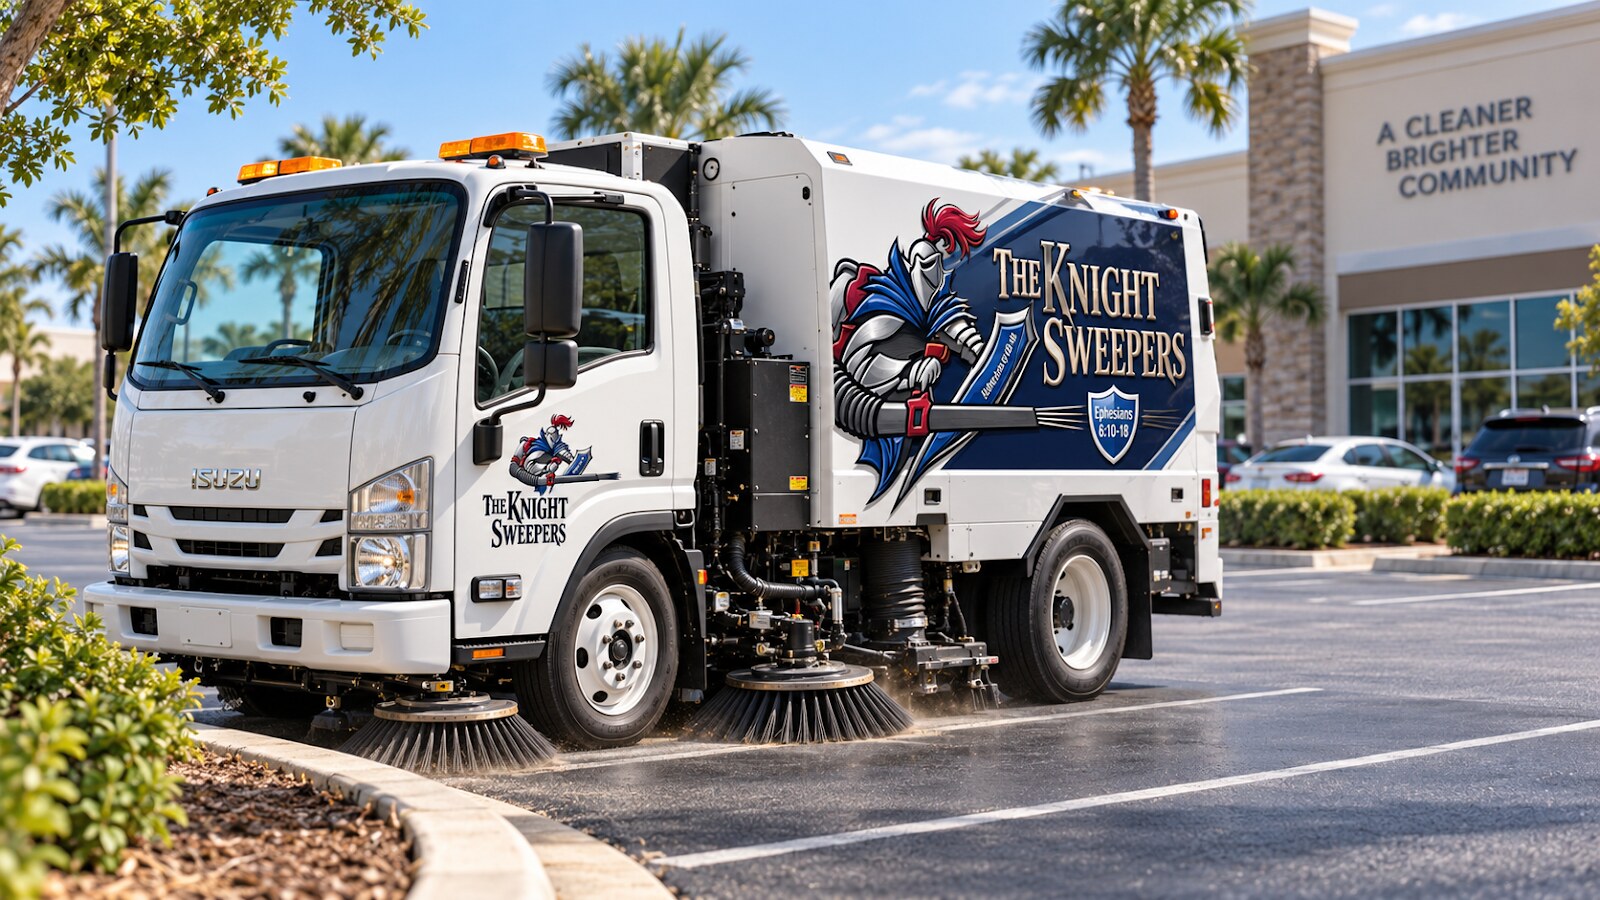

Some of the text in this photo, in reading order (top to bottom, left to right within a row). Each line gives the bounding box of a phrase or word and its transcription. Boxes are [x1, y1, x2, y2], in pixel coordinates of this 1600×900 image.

[1377, 96, 1532, 145] A CLEANER
[1386, 129, 1519, 172] BRIGHTER
[1398, 148, 1578, 199] COMMUNITY
[993, 240, 1159, 332] THE KNIGHT
[1043, 317, 1186, 386] SWEEPERS
[1094, 405, 1133, 422] Ephesians
[1098, 424, 1129, 437] 6:10-18
[191, 468, 261, 490] ISUZU
[482, 491, 568, 523] THE KNIGHT
[491, 519, 566, 548] SWEEPERS
